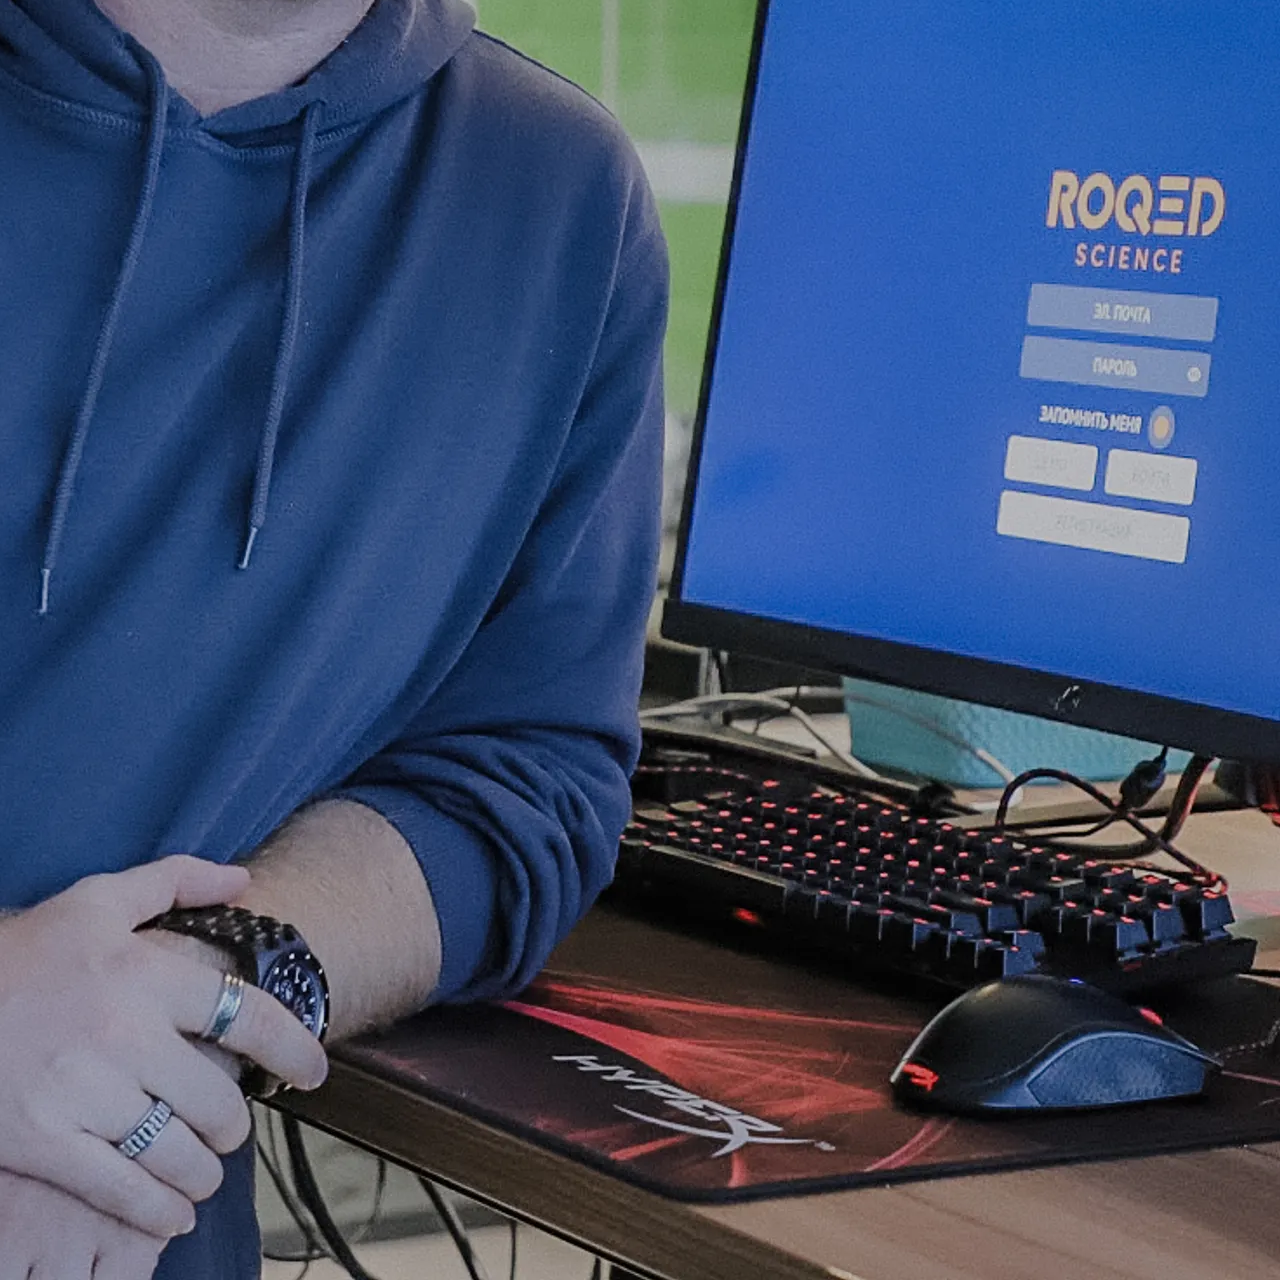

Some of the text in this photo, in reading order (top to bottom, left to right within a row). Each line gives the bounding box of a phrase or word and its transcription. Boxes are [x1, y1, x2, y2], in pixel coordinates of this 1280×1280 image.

[1046, 170, 1225, 236] ROQED
[1075, 243, 1183, 273] SCIENCE
[1113, 304, 1151, 324] ПОЧТА
[1092, 356, 1137, 377] ПАРОЛЬ
[1039, 405, 1142, 434] ЗАПОМНИТЬ МЕНЯ
